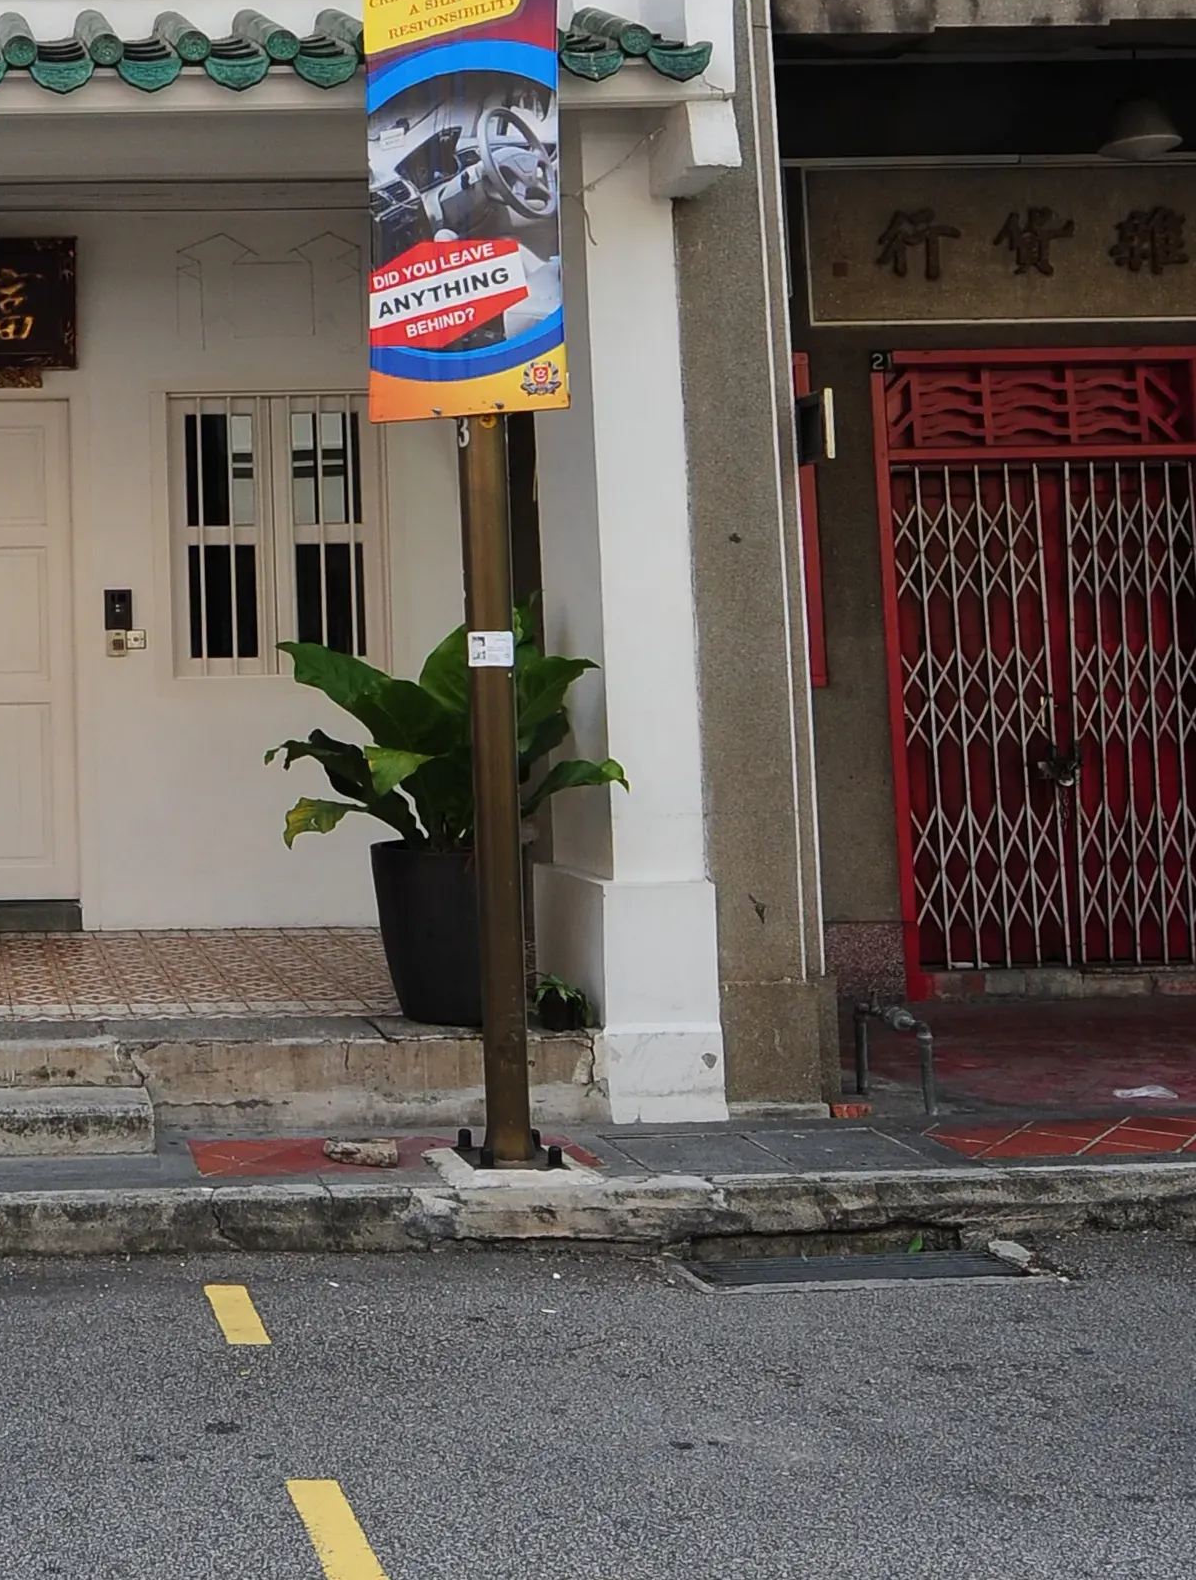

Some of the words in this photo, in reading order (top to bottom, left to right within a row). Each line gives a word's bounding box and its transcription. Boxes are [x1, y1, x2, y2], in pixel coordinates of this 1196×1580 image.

[408, 4, 420, 16] A
[372, 270, 400, 290] DID
[402, 258, 437, 280] YOU
[440, 242, 495, 270] LEAVE
[378, 267, 510, 319] ANYTHING
[405, 307, 476, 338] BEHIND?
